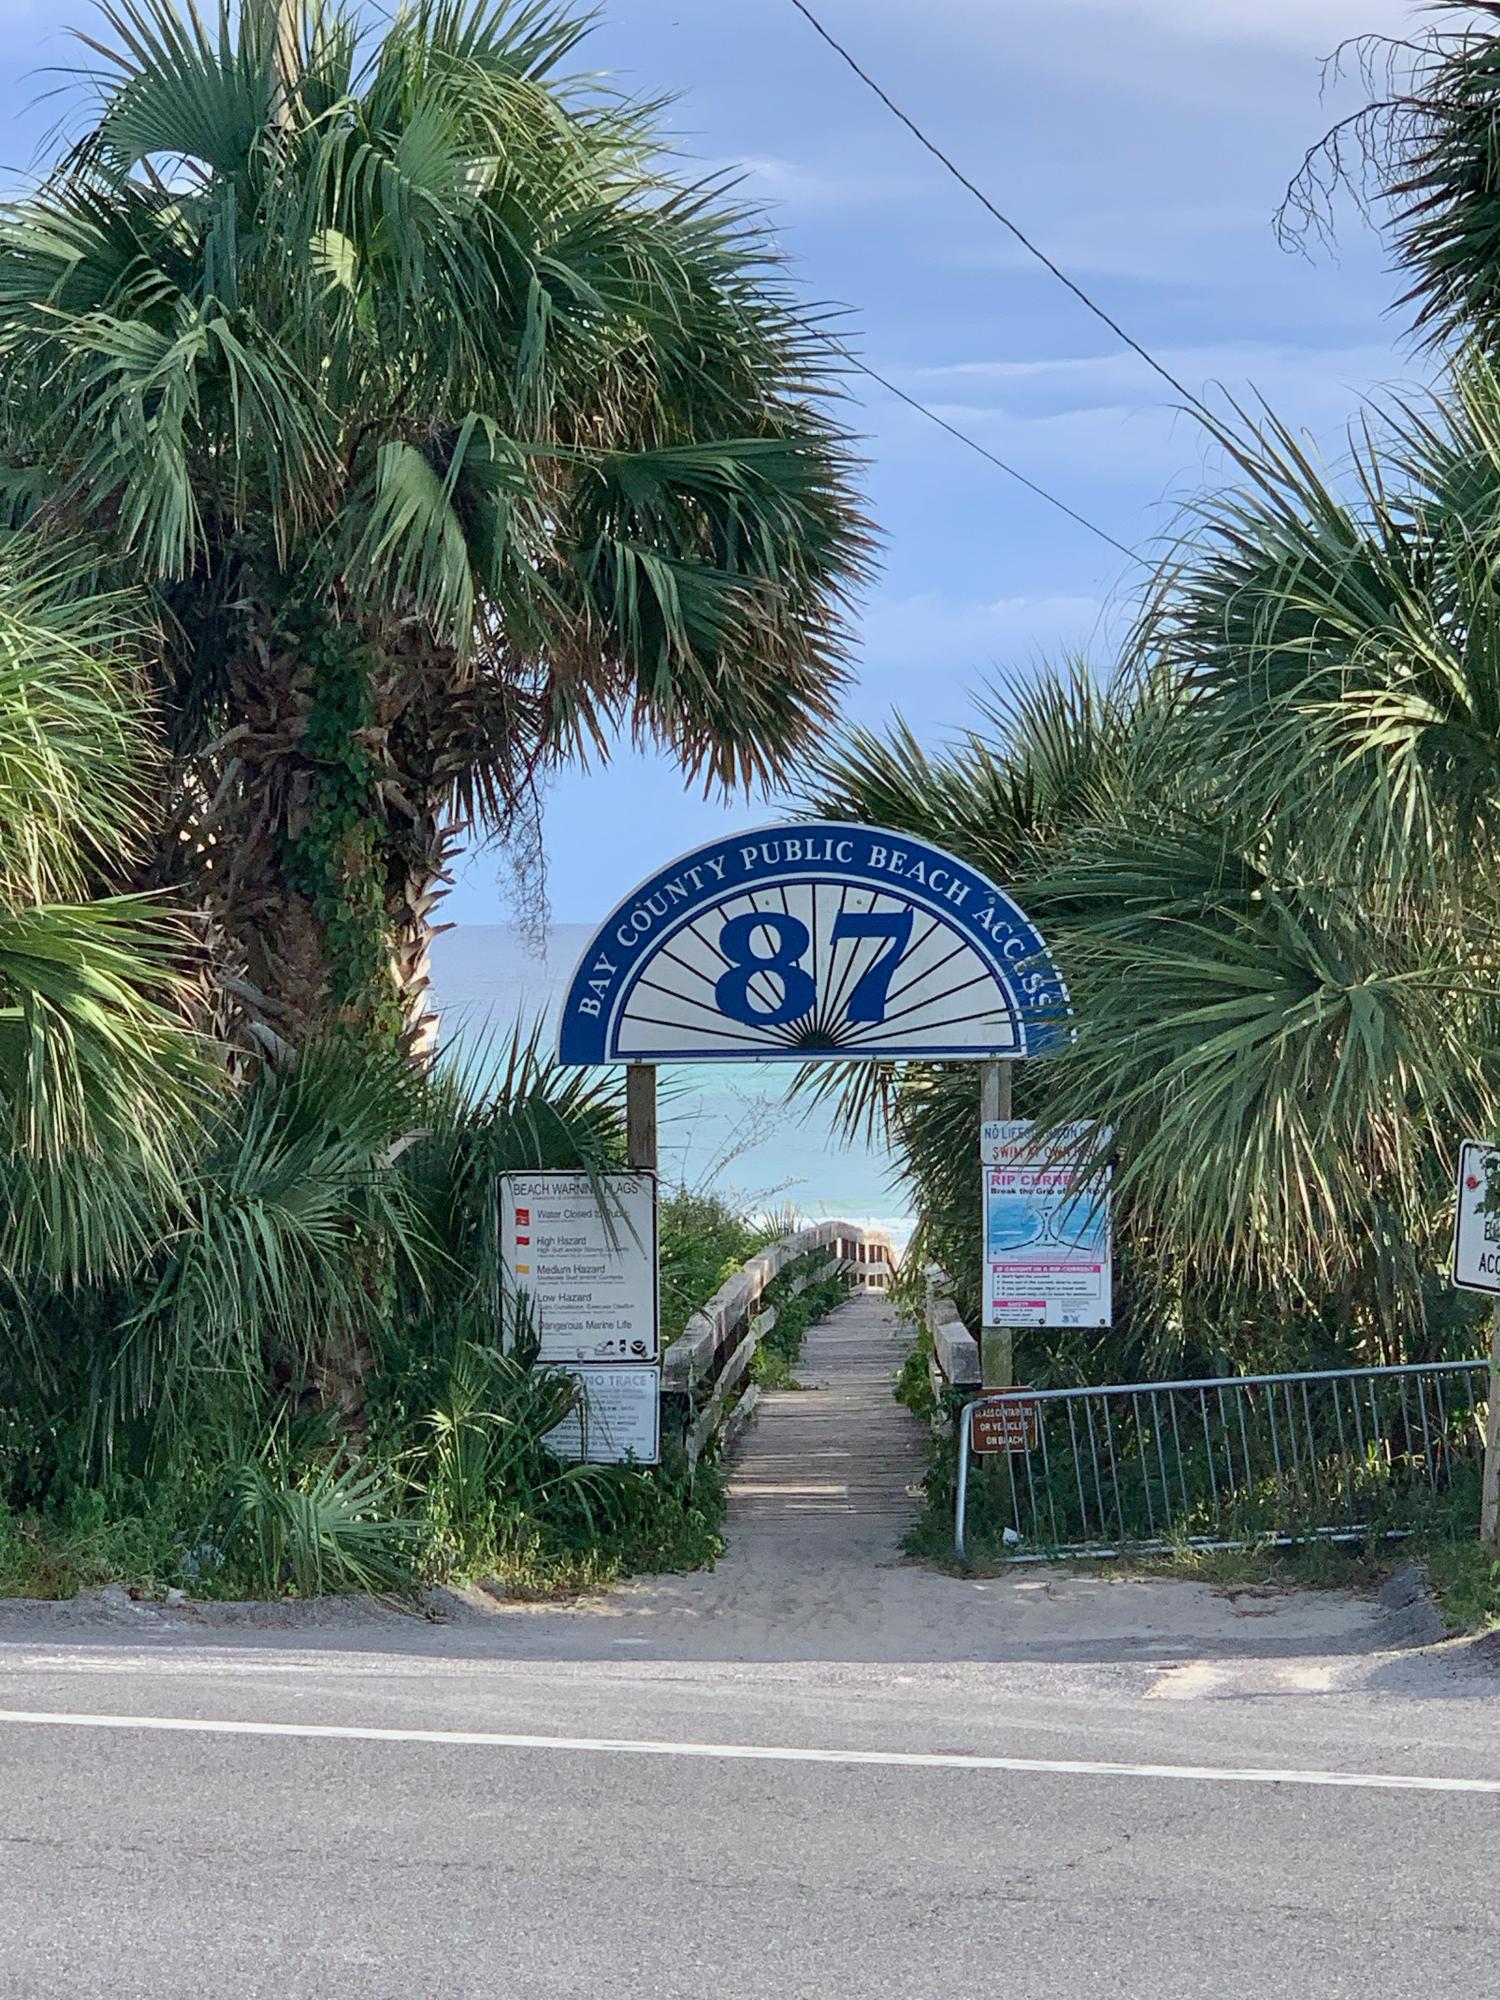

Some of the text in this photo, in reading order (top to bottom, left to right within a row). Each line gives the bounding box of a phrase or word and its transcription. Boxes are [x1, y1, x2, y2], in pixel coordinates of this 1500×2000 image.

[578, 952, 618, 1019] BAY
[616, 858, 726, 946] COUNTY
[740, 838, 854, 870] PUBLIC
[867, 845, 972, 907] BEACH
[715, 905, 914, 1026] 87
[984, 1127, 1000, 1139] NO
[991, 1174, 1016, 1185] RIP
[514, 1183, 549, 1195] BEACH
[563, 1208, 592, 1219] Closed
[537, 1236, 586, 1247] High Hazard
[537, 1264, 605, 1275] Medium Hazard
[537, 1292, 592, 1302] Low Hazard
[586, 1320, 614, 1329] Marine
[616, 1319, 632, 1329] Life
[609, 1375, 646, 1386] TRACE
[980, 1423, 990, 1432] OR
[986, 1436, 997, 1445] ON
